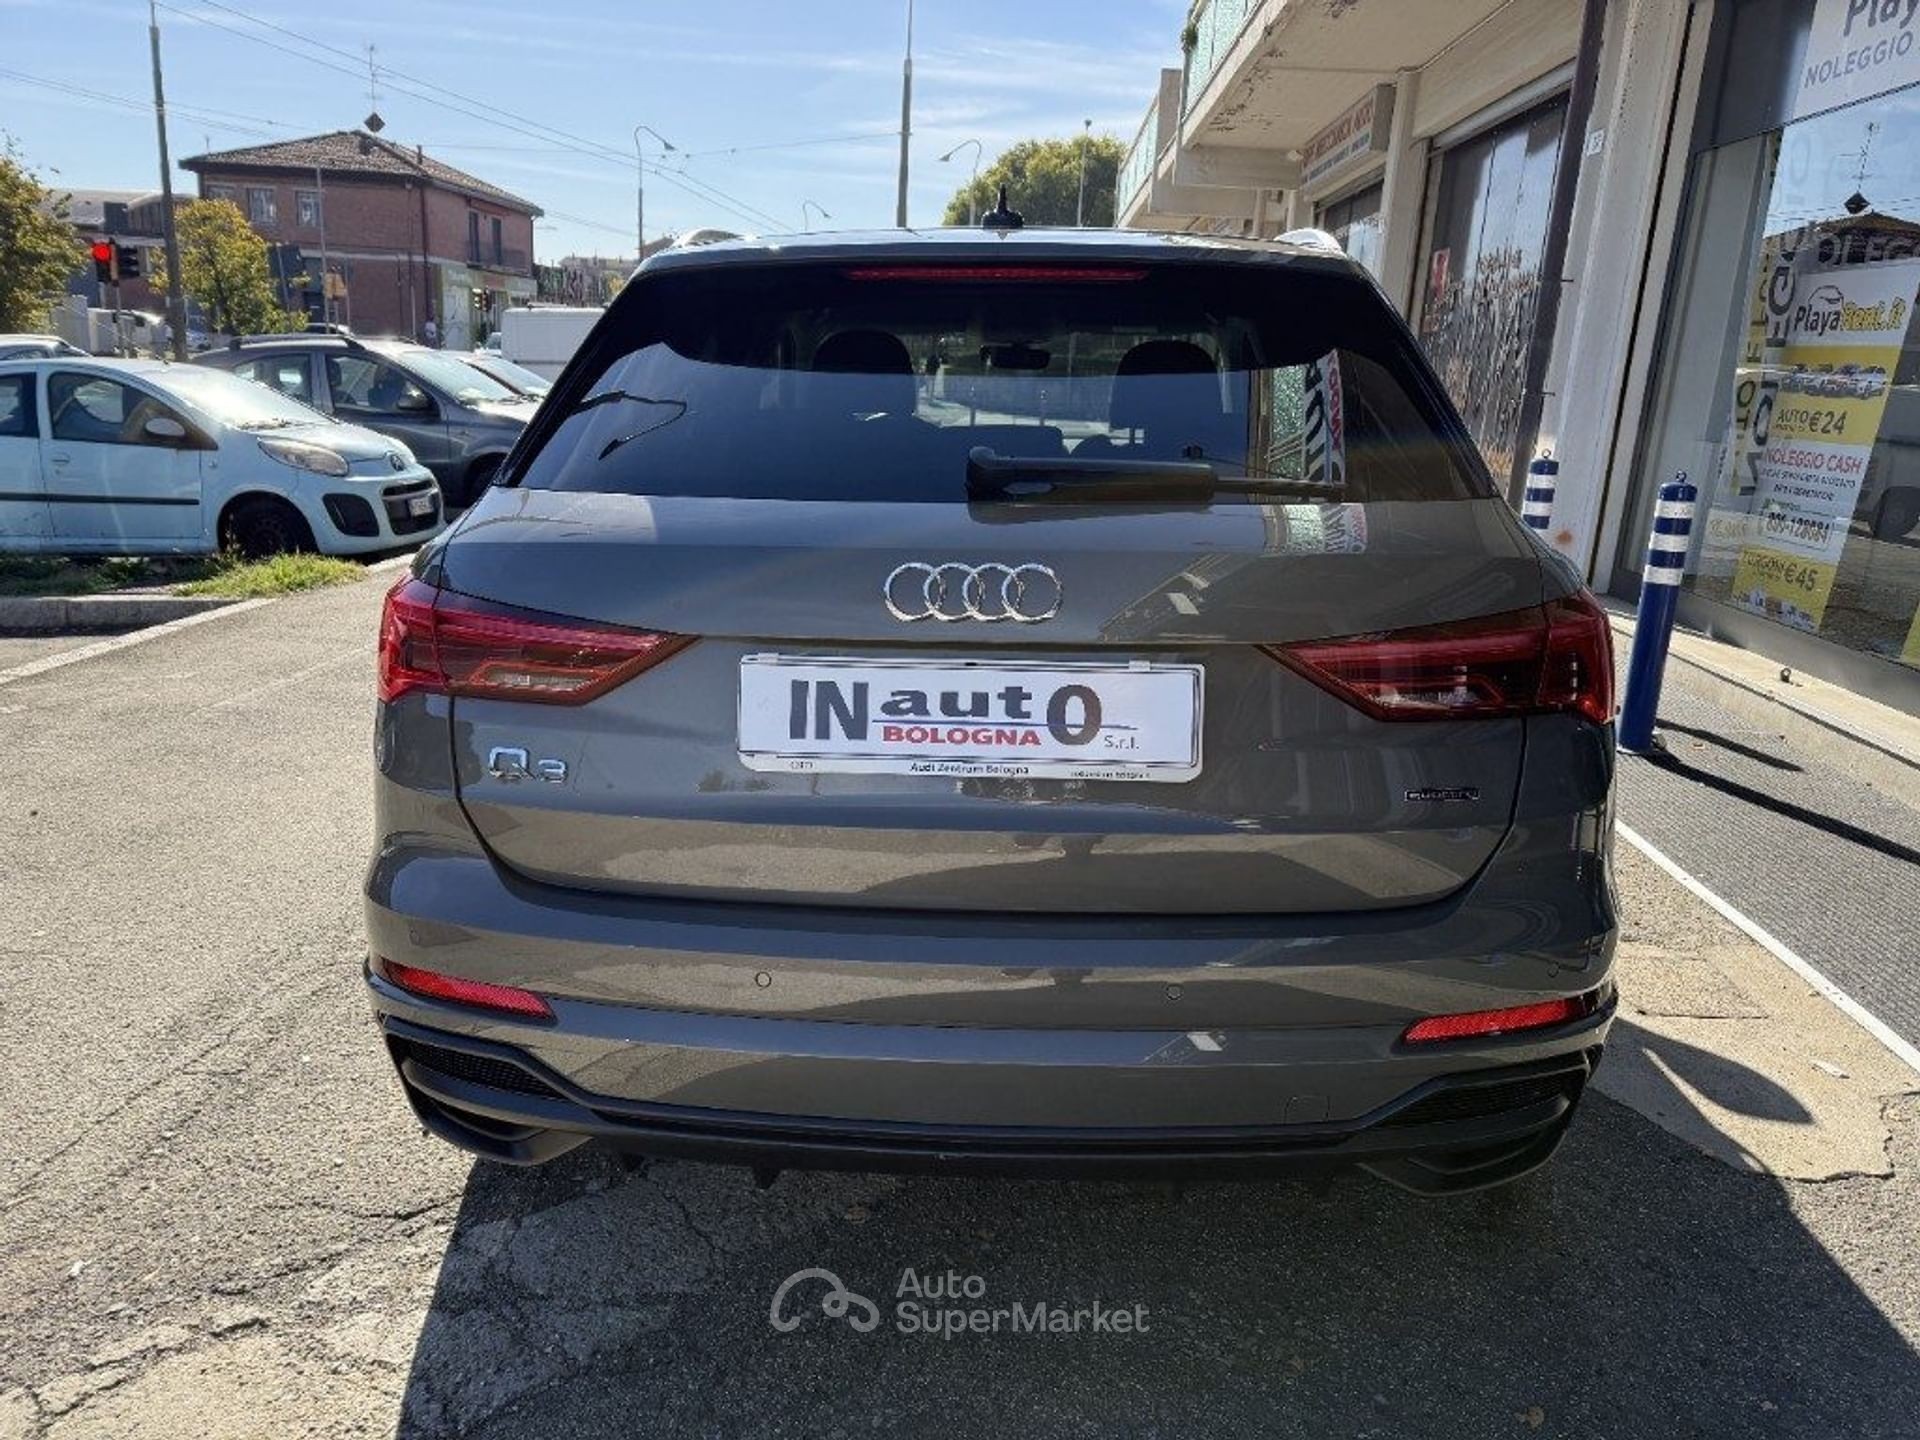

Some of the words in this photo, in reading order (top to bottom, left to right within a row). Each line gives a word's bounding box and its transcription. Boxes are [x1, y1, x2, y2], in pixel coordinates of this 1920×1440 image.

[1804, 31, 1914, 88] NOLEGGIO
[1776, 409, 1808, 424] AUTO
[1810, 411, 1848, 435] €24
[1765, 447, 1825, 469] NOLEGGIO
[1827, 455, 1864, 474] CASH
[1784, 565, 1818, 592] €45
[883, 726, 1041, 746] BOLOGNA
[489, 747, 568, 784] Q3
[910, 763, 935, 773] Audi
[937, 764, 984, 774] Zentrum
[986, 765, 1029, 776] Bologna
